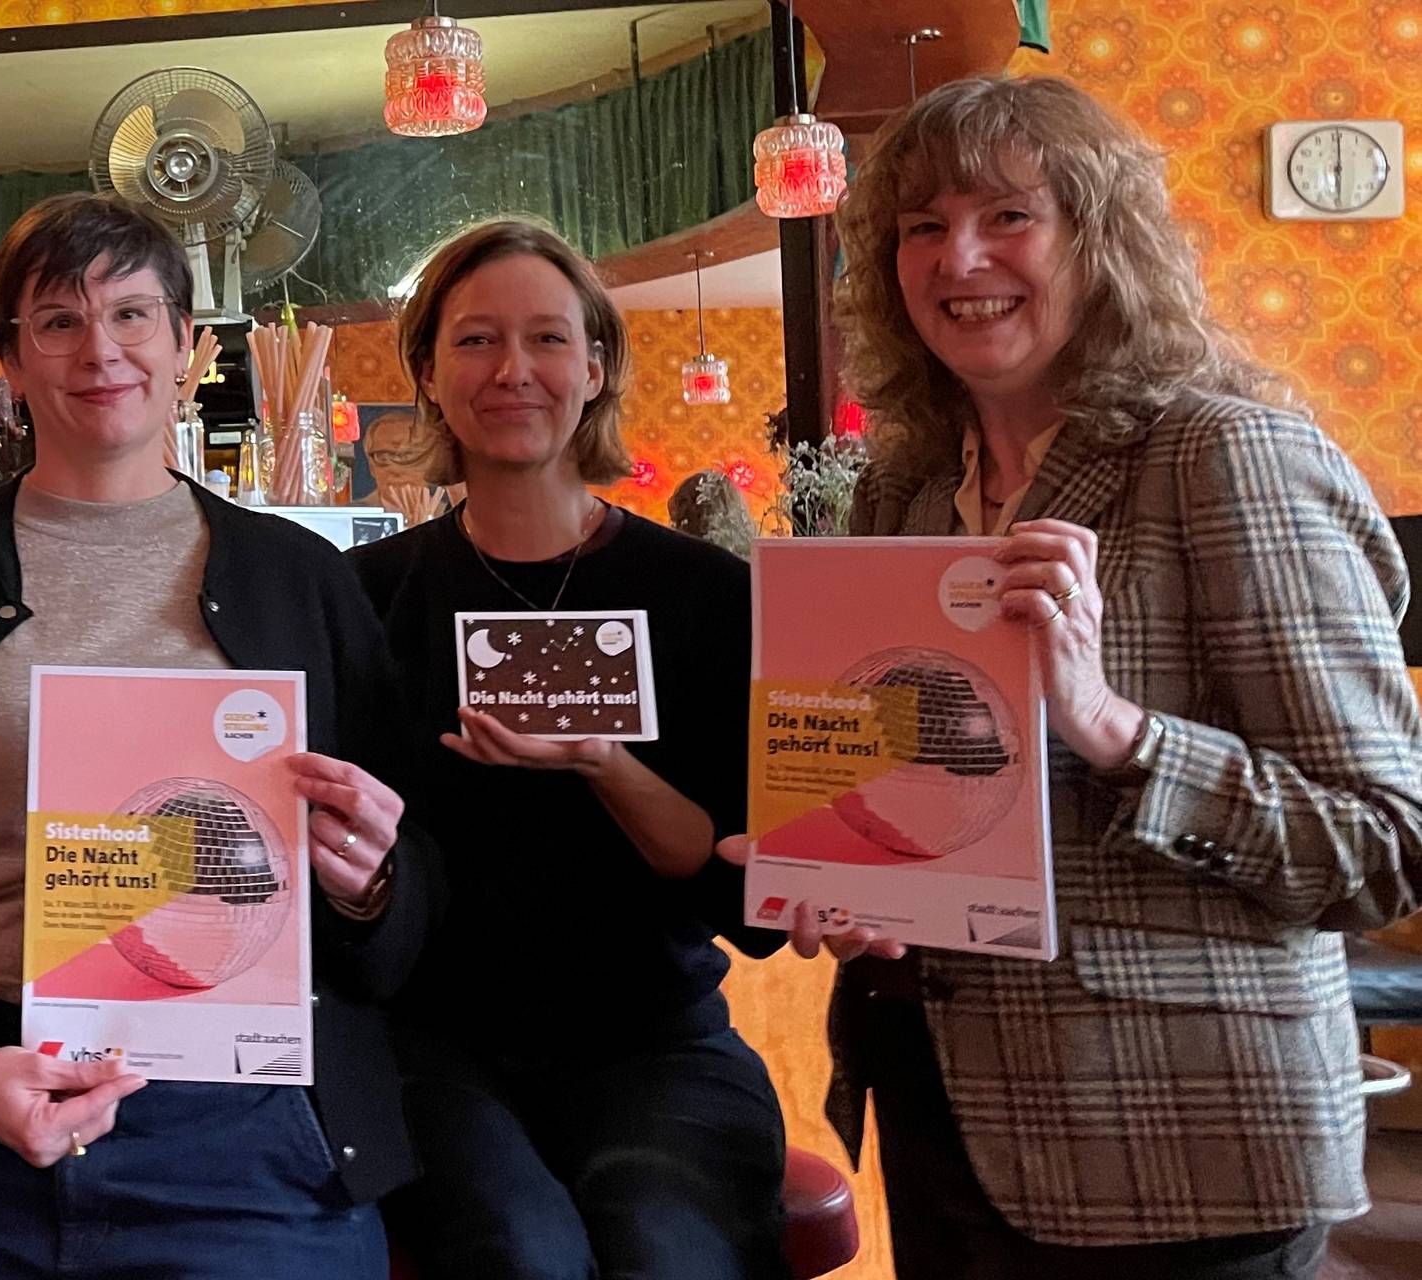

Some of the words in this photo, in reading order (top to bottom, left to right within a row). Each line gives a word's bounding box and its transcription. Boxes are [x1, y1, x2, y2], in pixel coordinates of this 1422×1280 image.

[468, 691, 496, 705] Die
[498, 691, 544, 705] Nacht
[547, 690, 600, 708] gehört
[603, 690, 637, 705] uns!
[768, 689, 873, 712] Sisterhood
[767, 713, 799, 729] Die
[804, 715, 861, 732] Nacht
[766, 735, 831, 755] gehört
[835, 741, 880, 757] uns!
[45, 822, 151, 843] Sisterhood
[45, 845, 77, 863] Die
[82, 848, 138, 865] Nacht
[44, 869, 108, 890] gehört
[114, 873, 157, 889] uns!
